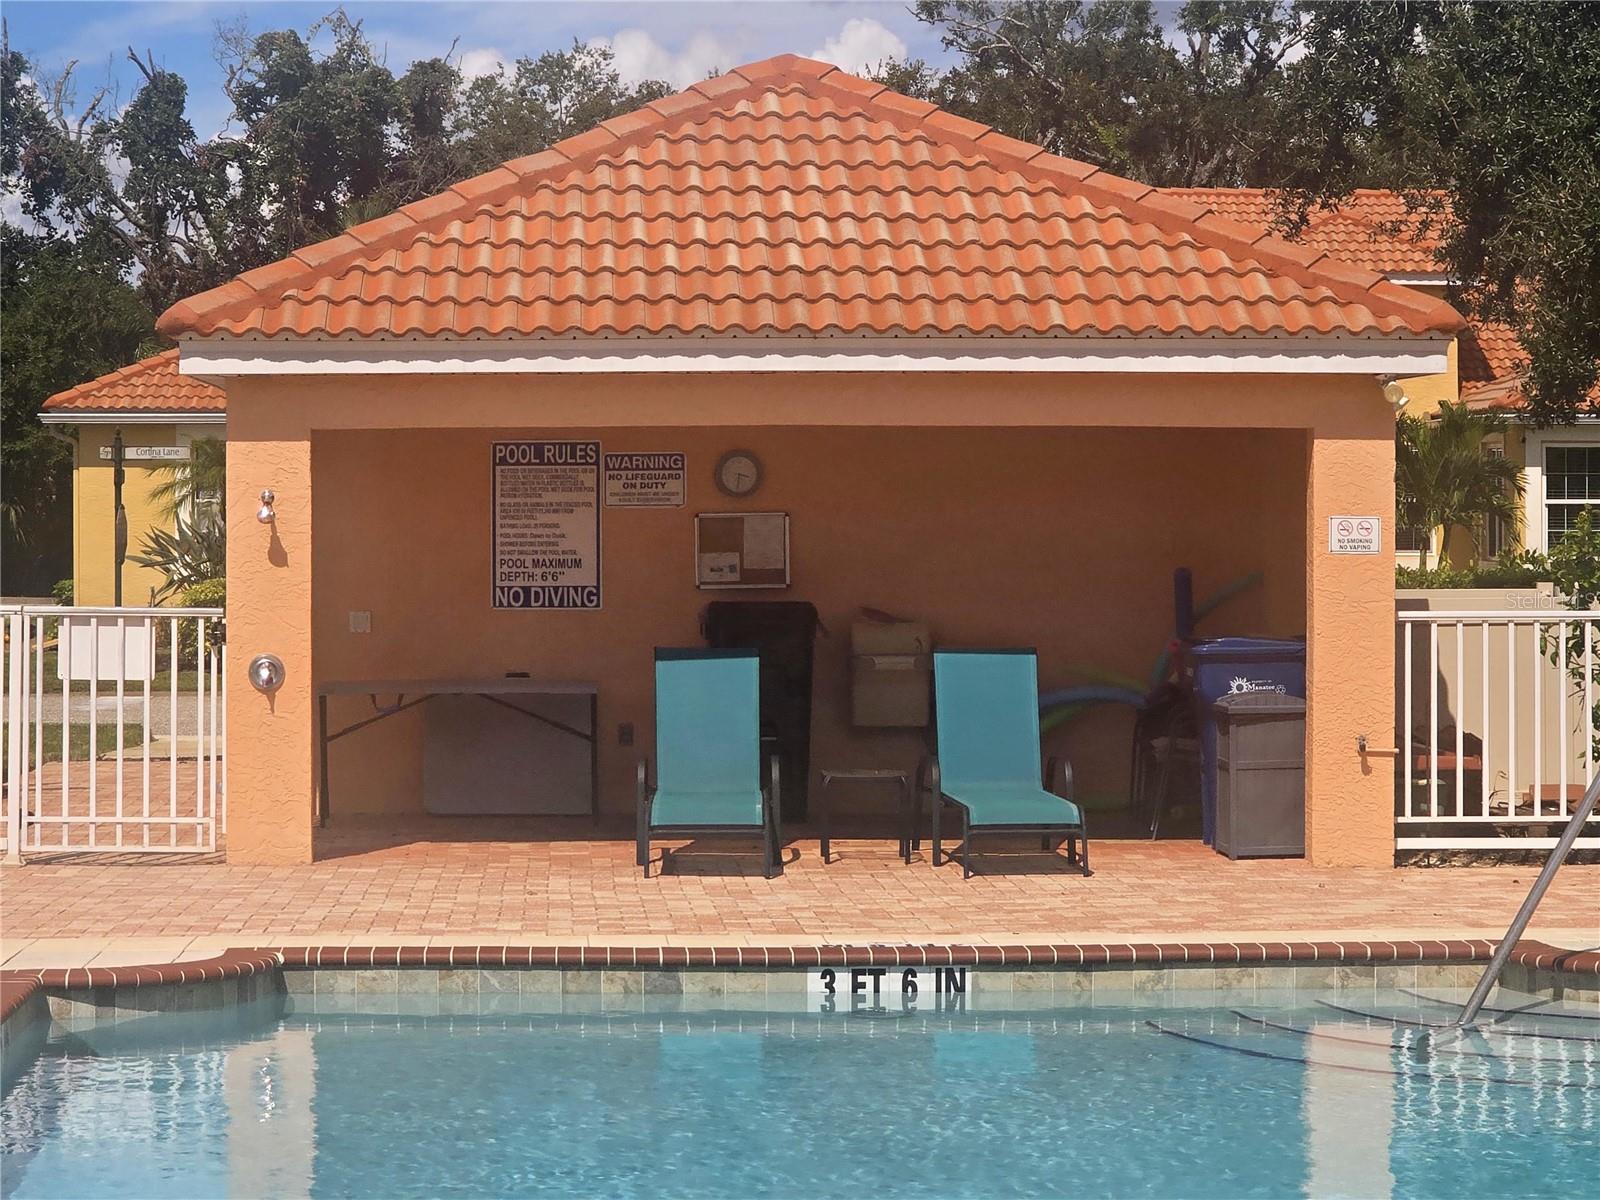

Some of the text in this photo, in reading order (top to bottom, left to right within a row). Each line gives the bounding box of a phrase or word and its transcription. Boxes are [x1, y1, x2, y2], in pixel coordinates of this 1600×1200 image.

[496, 445, 596, 463] POOL RULES
[607, 456, 682, 469] WARNING
[500, 559, 582, 568] POOL MAXIMUM
[500, 572, 538, 582] DEPTH:
[496, 587, 597, 606] NO DIVING
[820, 968, 966, 994] 3 FT 6 IN
